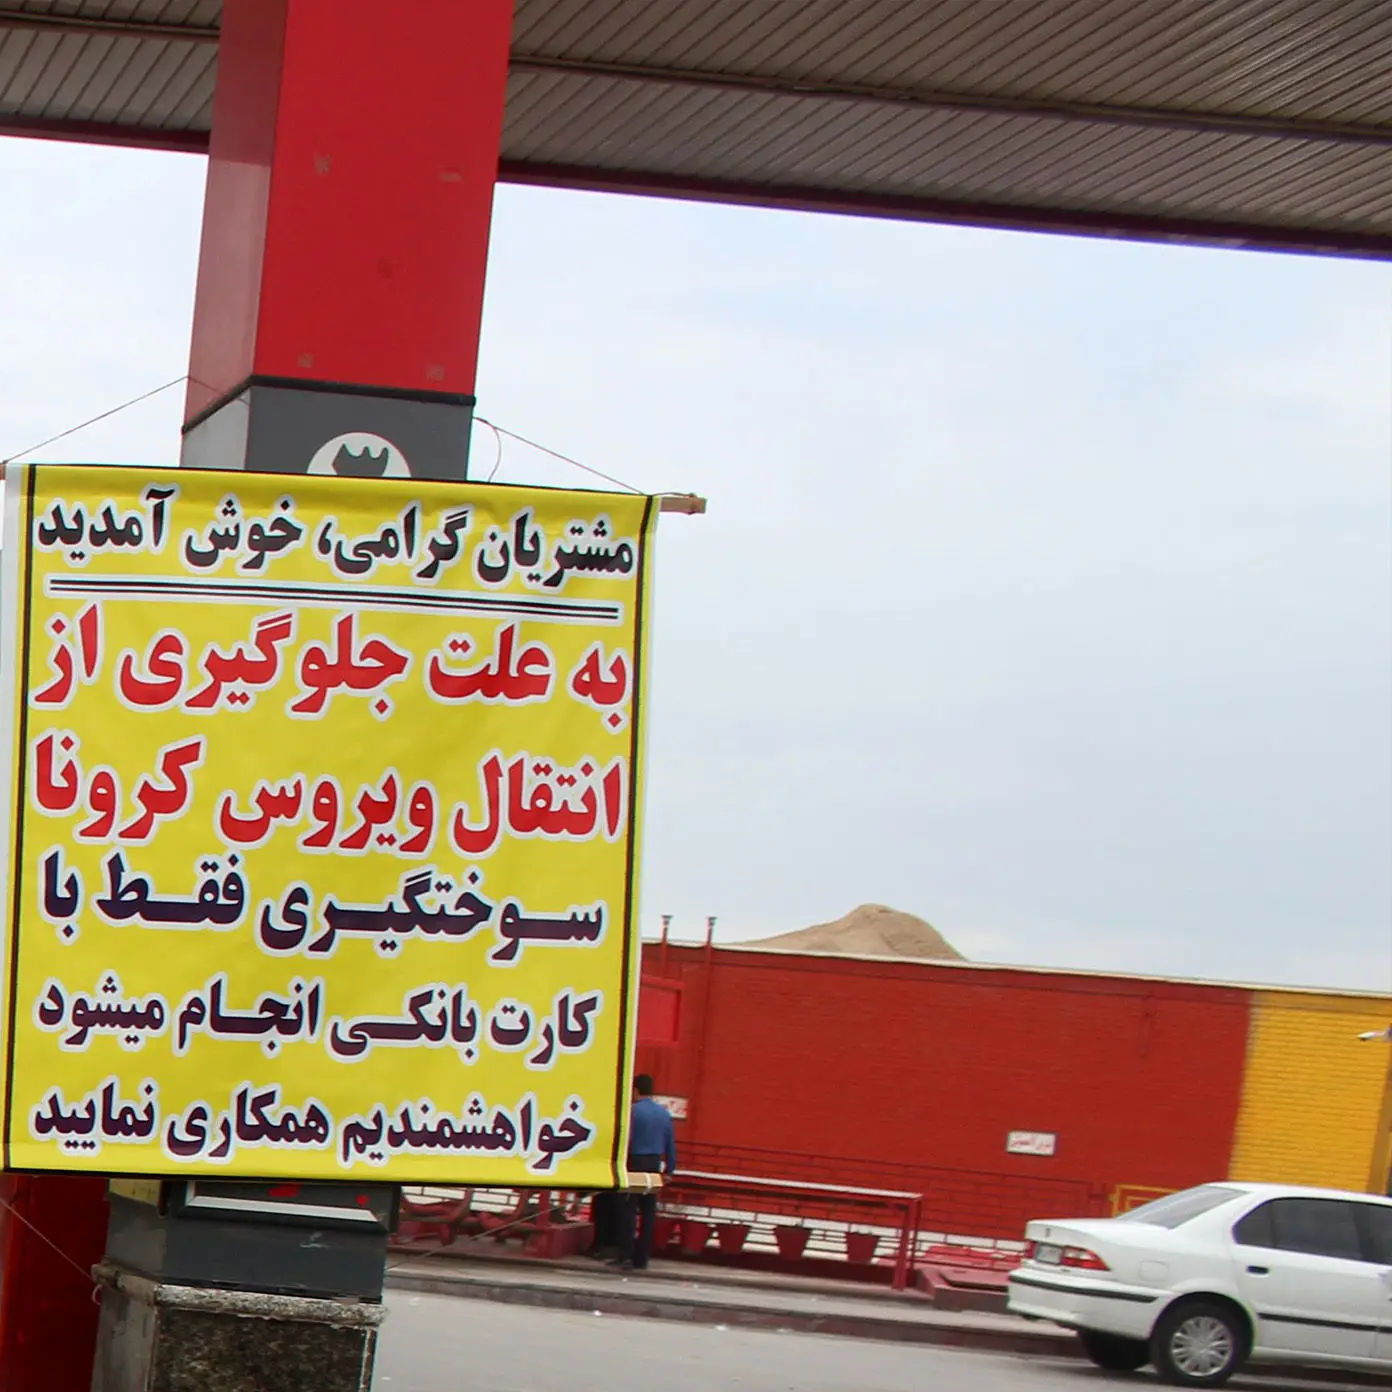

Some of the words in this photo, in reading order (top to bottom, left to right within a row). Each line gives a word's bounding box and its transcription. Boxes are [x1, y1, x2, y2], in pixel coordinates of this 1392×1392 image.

[39, 489, 175, 559] آمدید
[187, 500, 301, 569] خوش
[478, 513, 632, 587] مشتریان
[36, 606, 97, 702] از
[430, 625, 549, 699] علت
[573, 651, 625, 726] به
[37, 736, 200, 838] کرونا
[221, 776, 433, 852] ویروس
[455, 757, 620, 852] انتقال
[45, 852, 78, 937] با
[97, 853, 244, 924] فقط
[179, 980, 319, 1050] انجام
[332, 990, 476, 1057] بانکی
[492, 995, 596, 1063] کارت
[36, 1083, 154, 1148] نمایید
[168, 1089, 328, 1157] همکاری
[344, 1099, 590, 1169] خواهشمندیم
